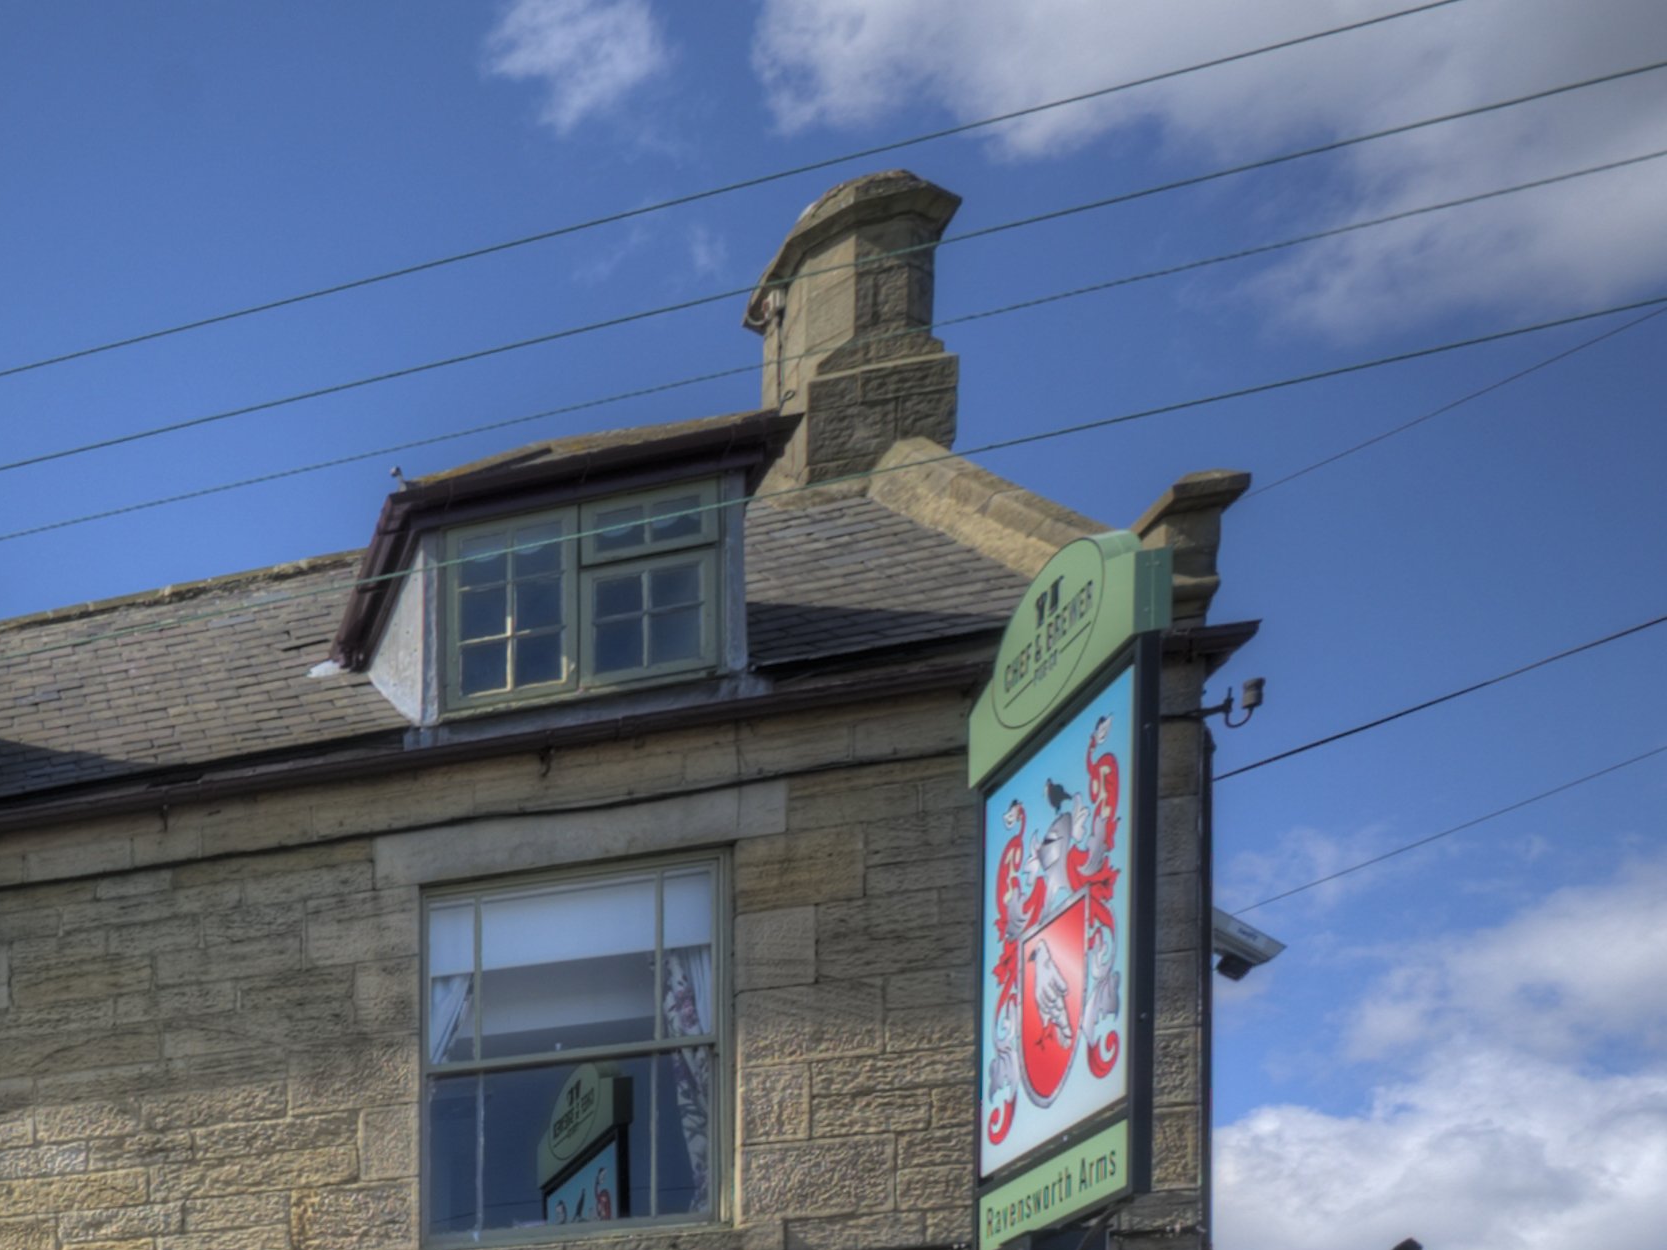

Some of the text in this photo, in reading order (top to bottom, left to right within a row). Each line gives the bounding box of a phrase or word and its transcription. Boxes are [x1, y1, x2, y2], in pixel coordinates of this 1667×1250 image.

[1005, 580, 1093, 693] CHEF & BREWER
[985, 1149, 1117, 1239] Ravensworth Arms
